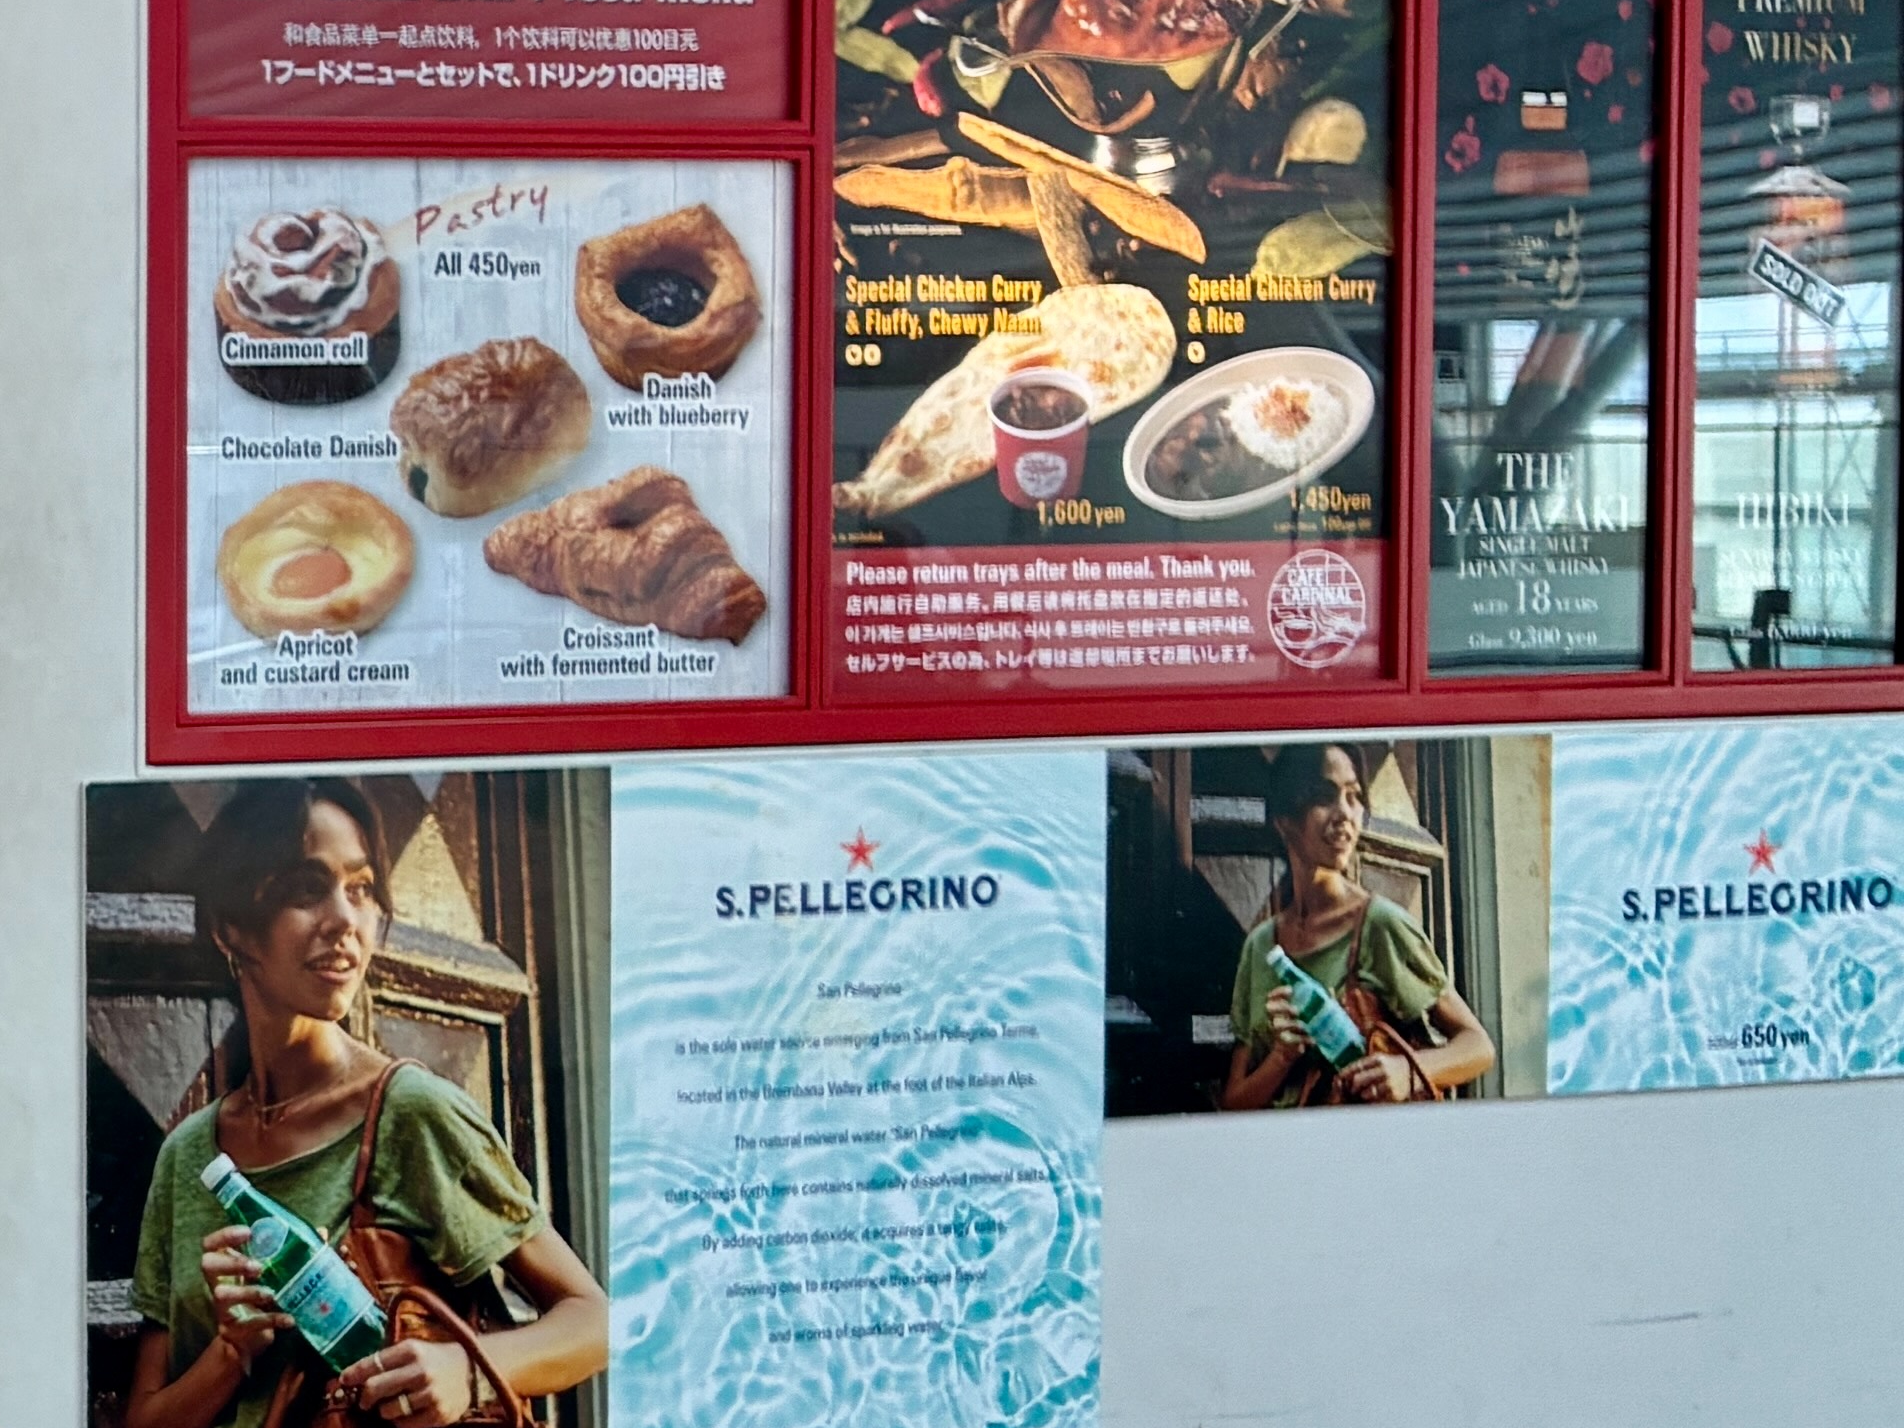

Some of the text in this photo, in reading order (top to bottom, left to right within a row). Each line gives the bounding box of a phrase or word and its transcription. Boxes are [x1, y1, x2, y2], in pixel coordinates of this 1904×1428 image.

[1743, 31, 1856, 64] WHISKY
[413, 183, 548, 244] Pastry
[434, 251, 541, 279] All 450yen
[846, 275, 1042, 305] Special Chicken Curry
[1188, 274, 1376, 304] Special Chicken Curry
[1207, 309, 1244, 334] Rice
[225, 337, 364, 361] Cinnamon roll
[647, 376, 712, 401] Danish
[609, 404, 749, 432] with blueberry
[221, 435, 398, 460] Chocolate Danish
[1497, 453, 1573, 490] THE
[846, 556, 1254, 586] Please return trays after the meal. Thank you.
[279, 635, 354, 661] Apricot
[563, 627, 655, 651] Croissant
[221, 660, 409, 684] and custard cream
[501, 651, 715, 678] with fermented butter
[716, 876, 997, 918] S.PELLEGRINO
[1622, 878, 1893, 923] S.PELLEGRINO
